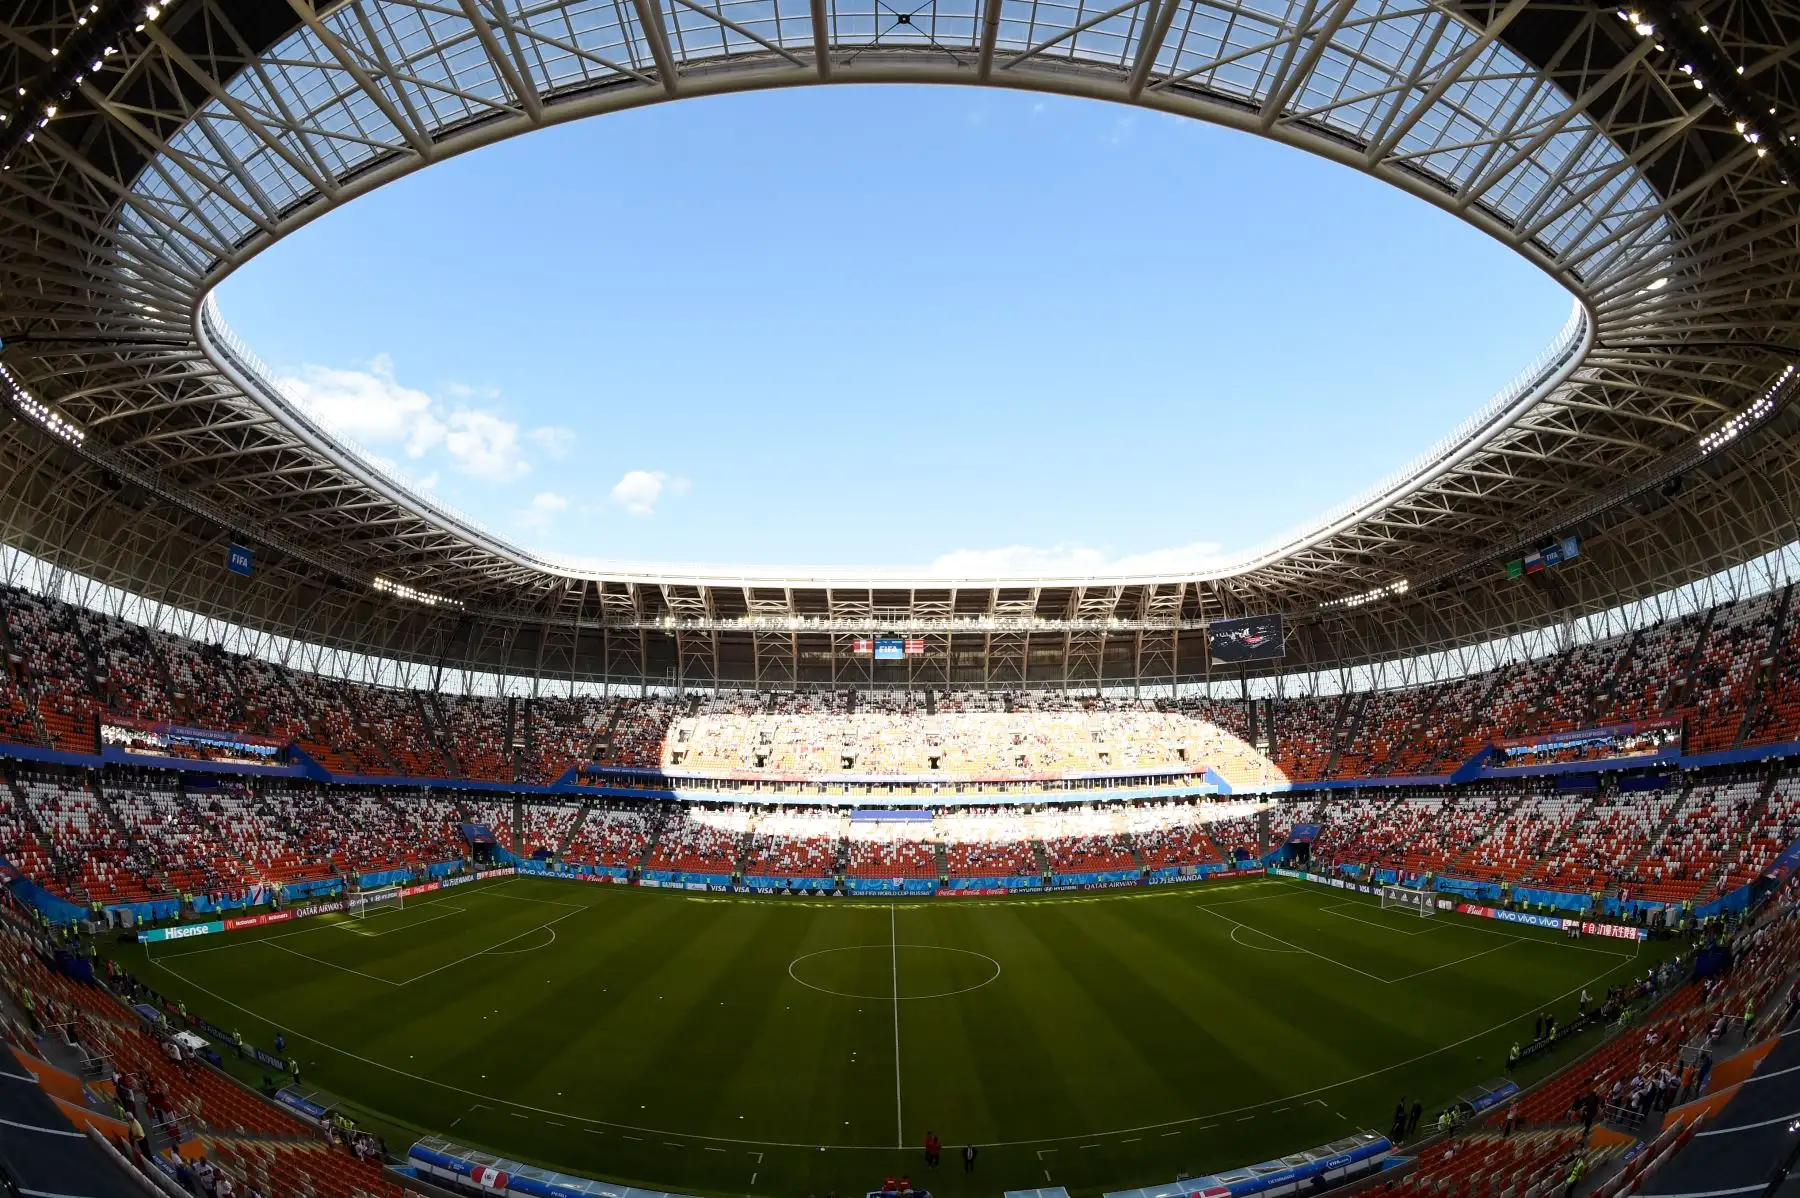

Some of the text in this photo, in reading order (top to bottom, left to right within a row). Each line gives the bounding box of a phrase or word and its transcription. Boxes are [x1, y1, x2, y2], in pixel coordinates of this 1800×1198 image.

[232, 553, 248, 568] FIFA
[1546, 551, 1558, 561] FIFA
[879, 645, 899, 653] FIFA
[1276, 868, 1300, 878] Hisense
[1176, 874, 1202, 882] WANDA
[711, 884, 727, 892] VISA
[1109, 880, 1137, 888] AIRWAYS
[1345, 881, 1355, 890] VISA
[733, 885, 750, 893] VISA
[1360, 885, 1370, 893] VISA
[297, 902, 343, 917] QATAR AIRWAYS
[1466, 903, 1483, 915] Bud
[165, 923, 209, 940] Hisense
